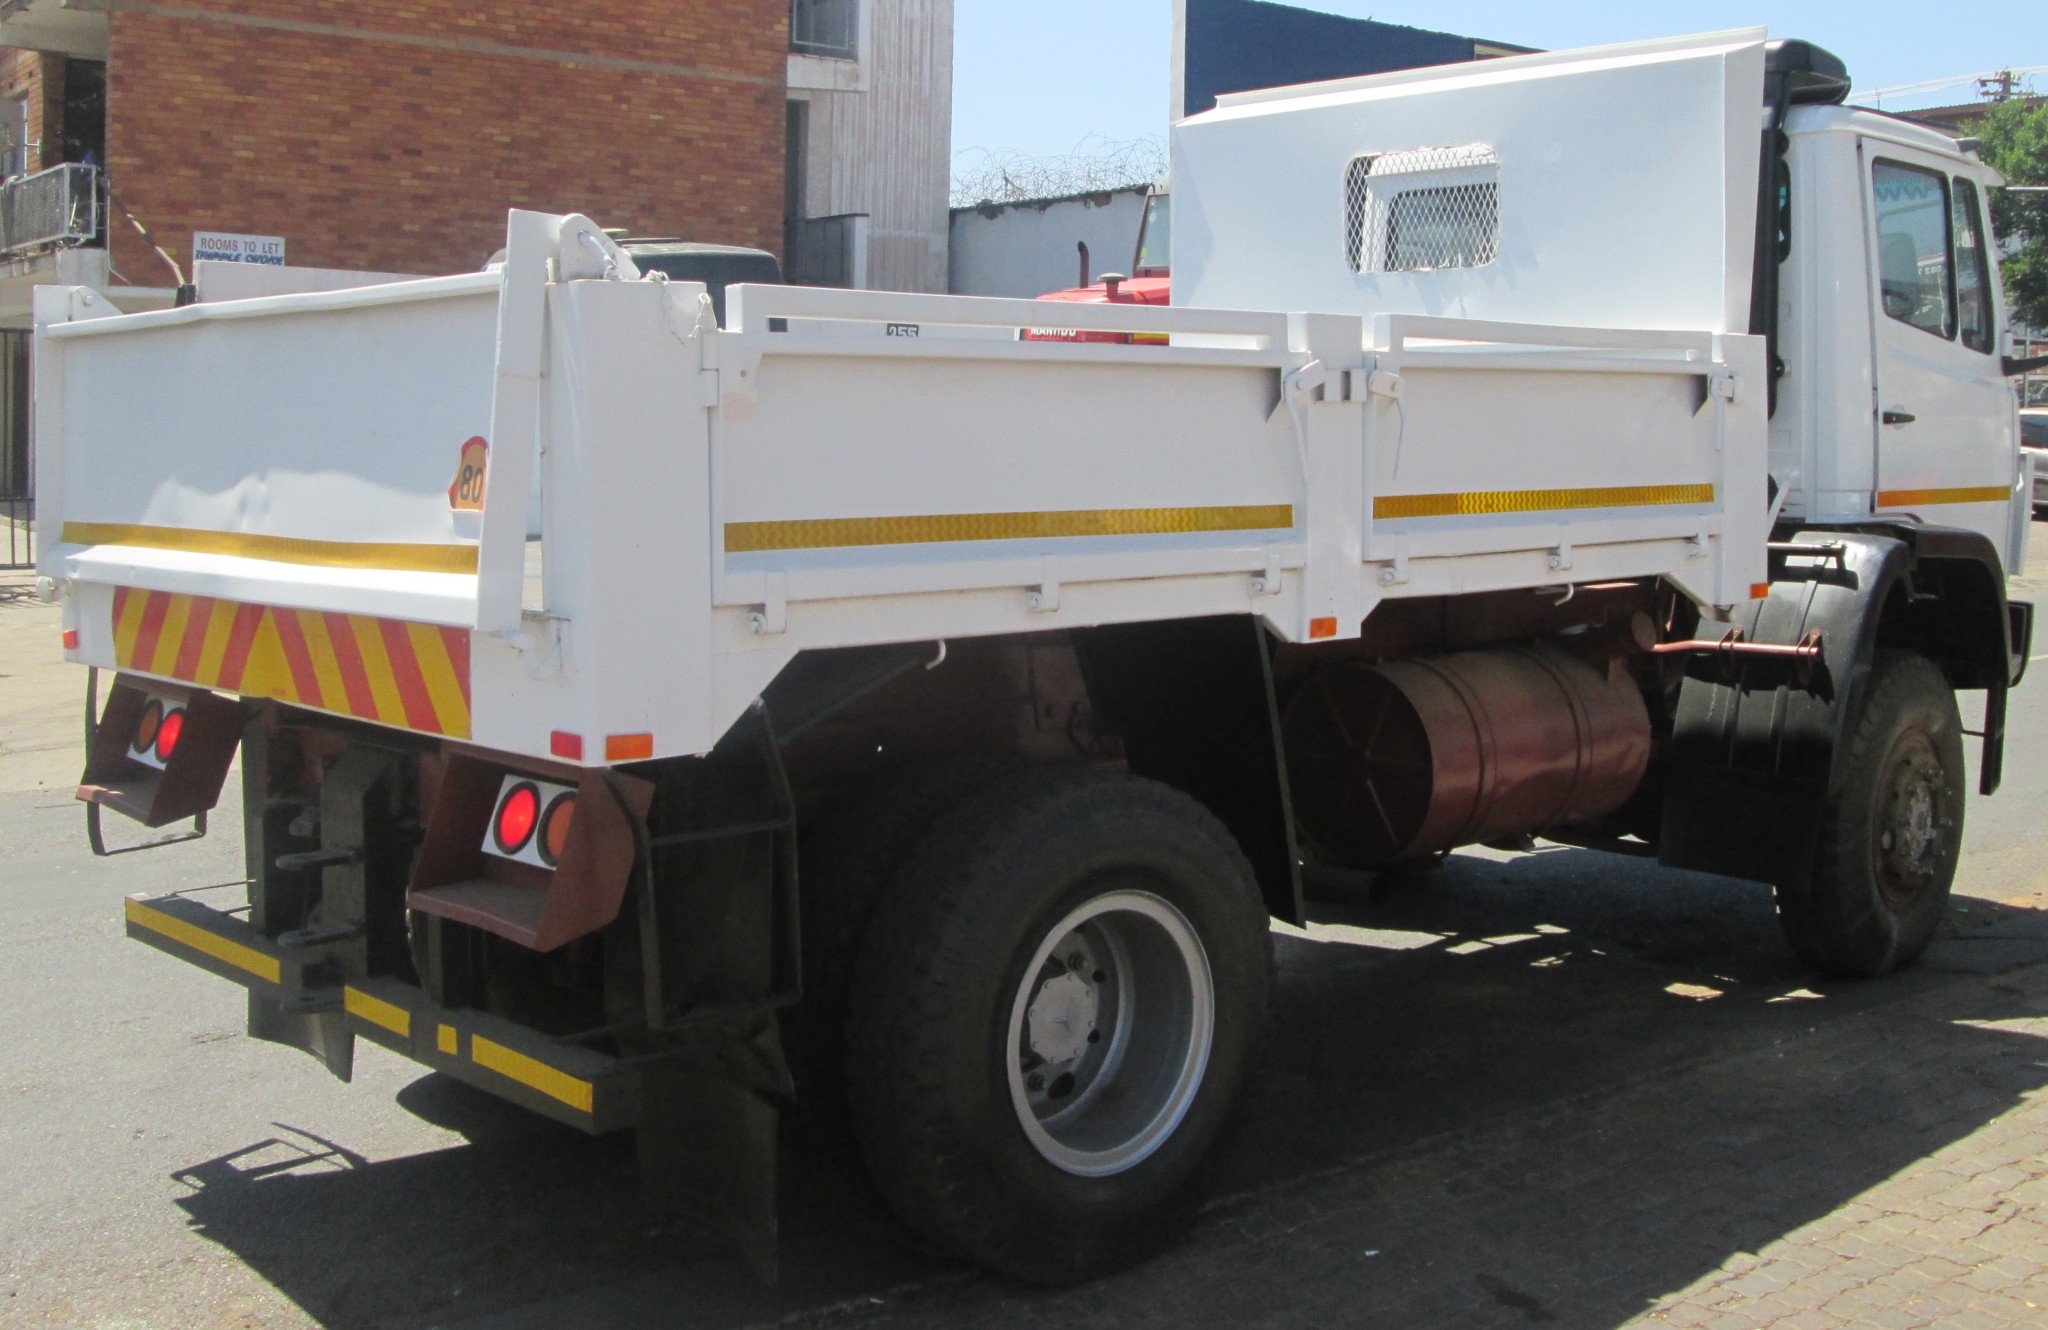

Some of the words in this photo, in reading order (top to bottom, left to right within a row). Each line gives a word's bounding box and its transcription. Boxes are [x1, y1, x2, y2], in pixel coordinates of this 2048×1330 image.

[201, 238, 238, 252] ROOMS
[243, 241, 256, 253] TO
[262, 242, 280, 254] LET
[460, 464, 483, 502] 80
